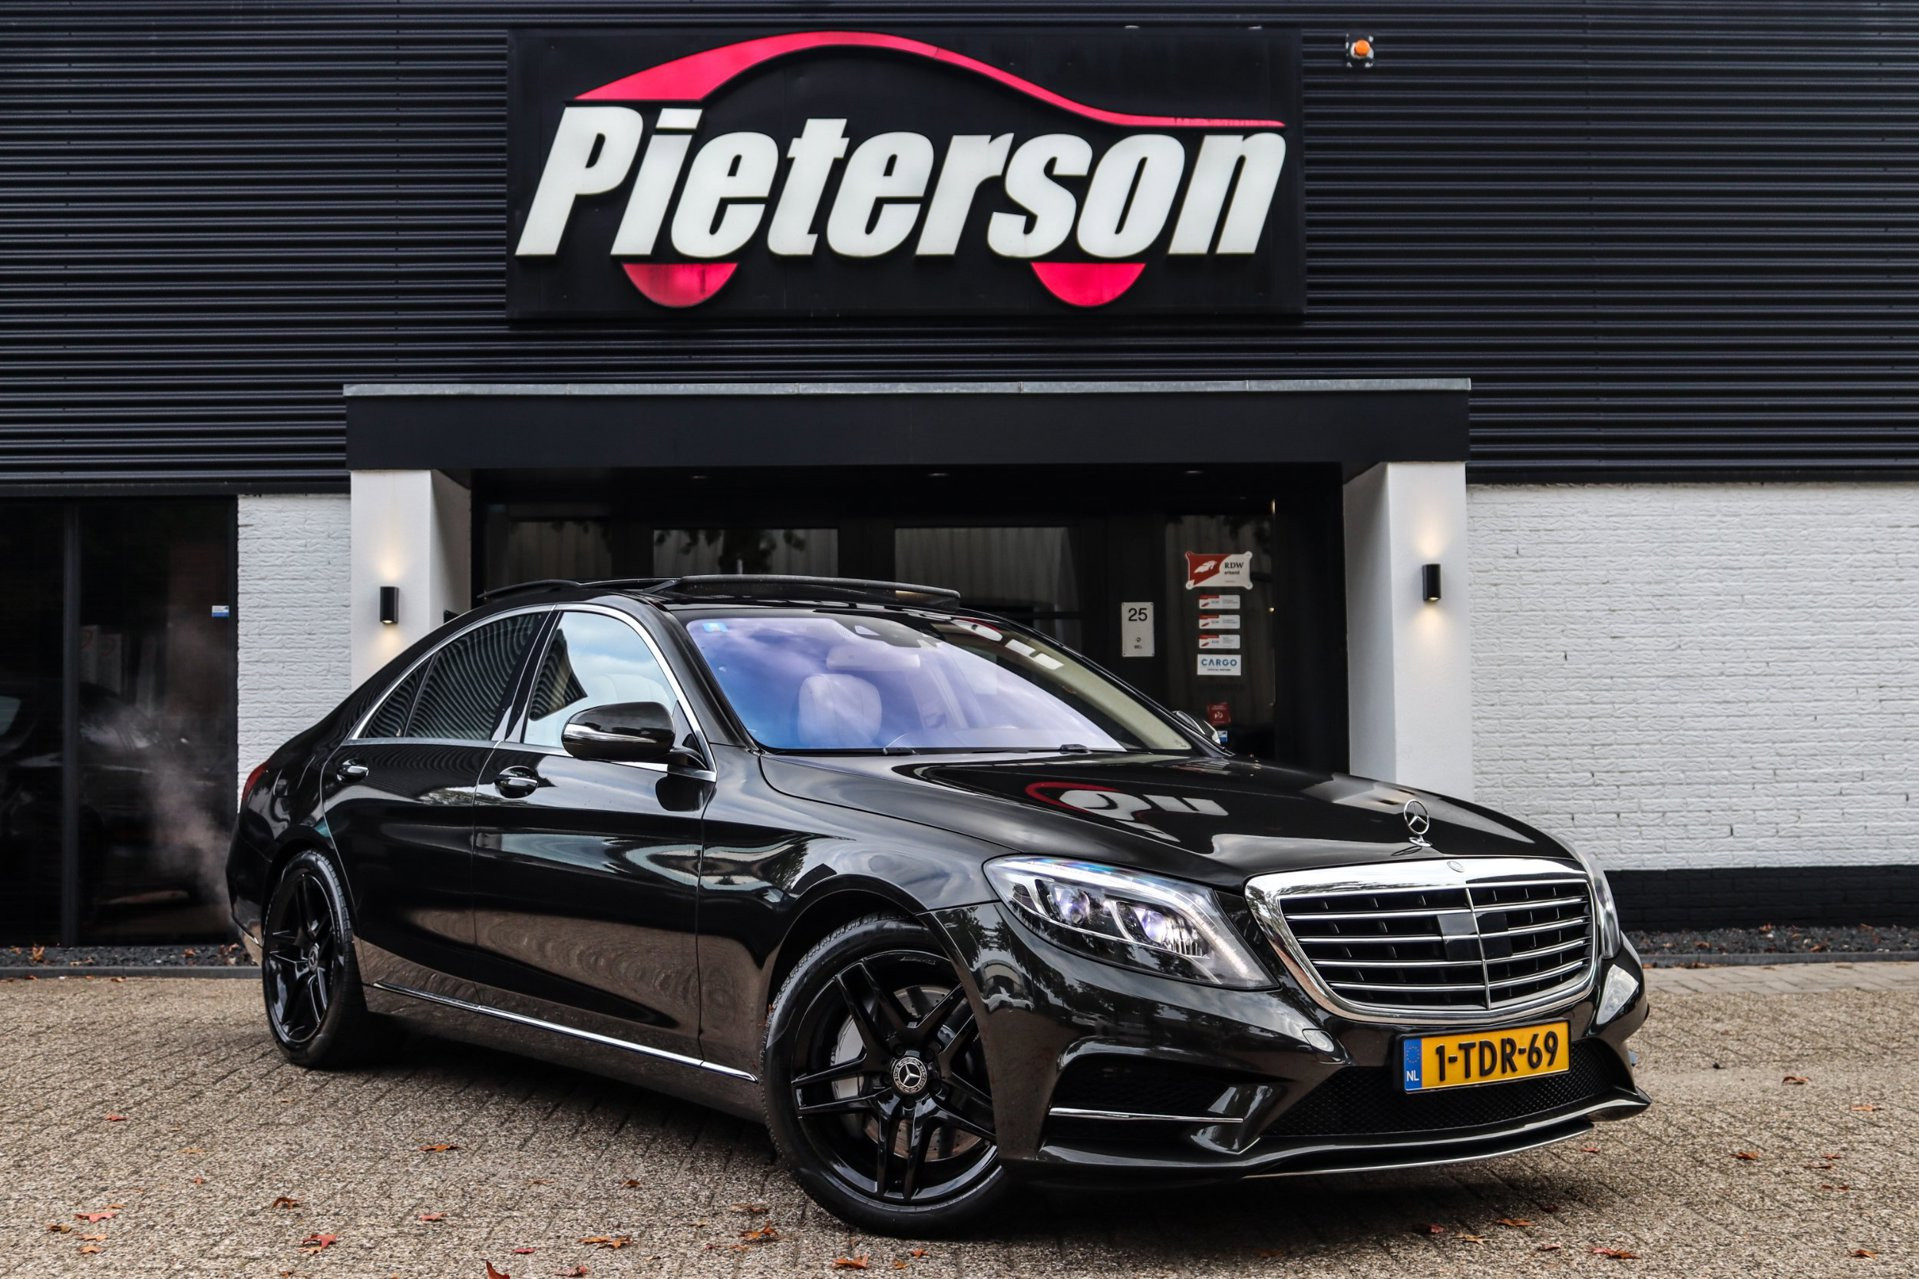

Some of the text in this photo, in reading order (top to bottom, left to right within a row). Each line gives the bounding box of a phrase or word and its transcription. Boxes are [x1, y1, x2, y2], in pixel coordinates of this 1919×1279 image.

[514, 105, 1287, 258] Pieterson
[1224, 561, 1244, 569] RDW
[1128, 607, 1148, 622] 25
[1201, 658, 1238, 667] CARGO
[1435, 1031, 1559, 1082] 1-TDR-69
[1406, 1070, 1420, 1082] NL
